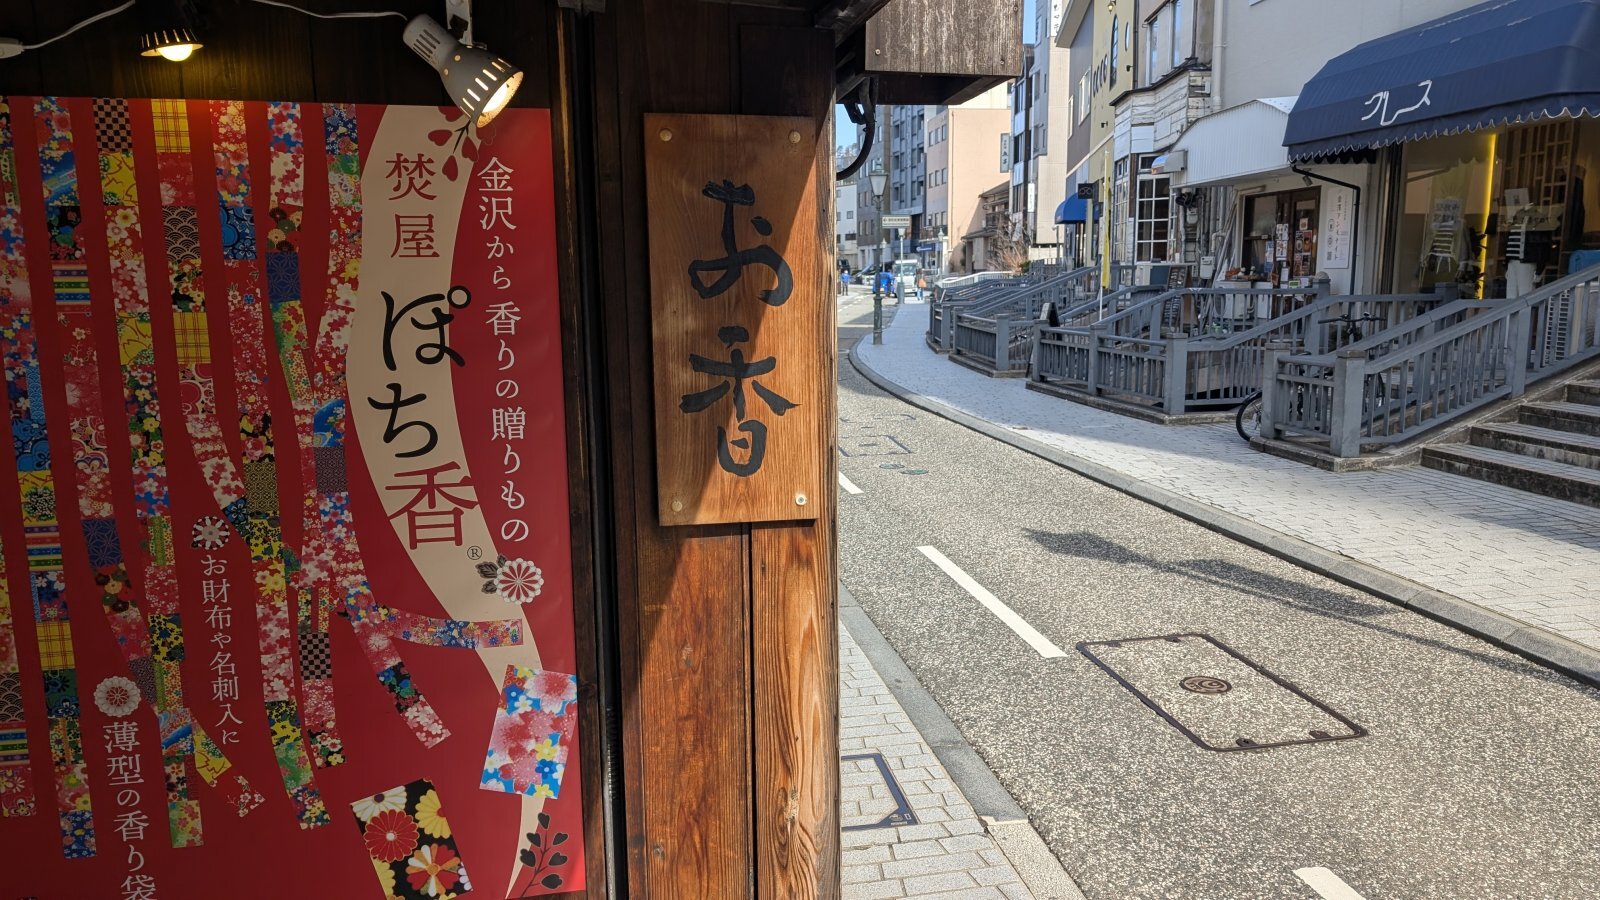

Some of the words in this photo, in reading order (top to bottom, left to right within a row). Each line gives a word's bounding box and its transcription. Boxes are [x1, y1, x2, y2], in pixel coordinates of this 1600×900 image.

[385, 152, 440, 259] 焚屋
[367, 285, 480, 550] ぽち香
[477, 156, 529, 542] 金沢から香りの贈りもの
[679, 178, 803, 478] お香
[200, 554, 243, 745] お財布や名刺入に
[102, 720, 157, 900] 薄型の香り袋
